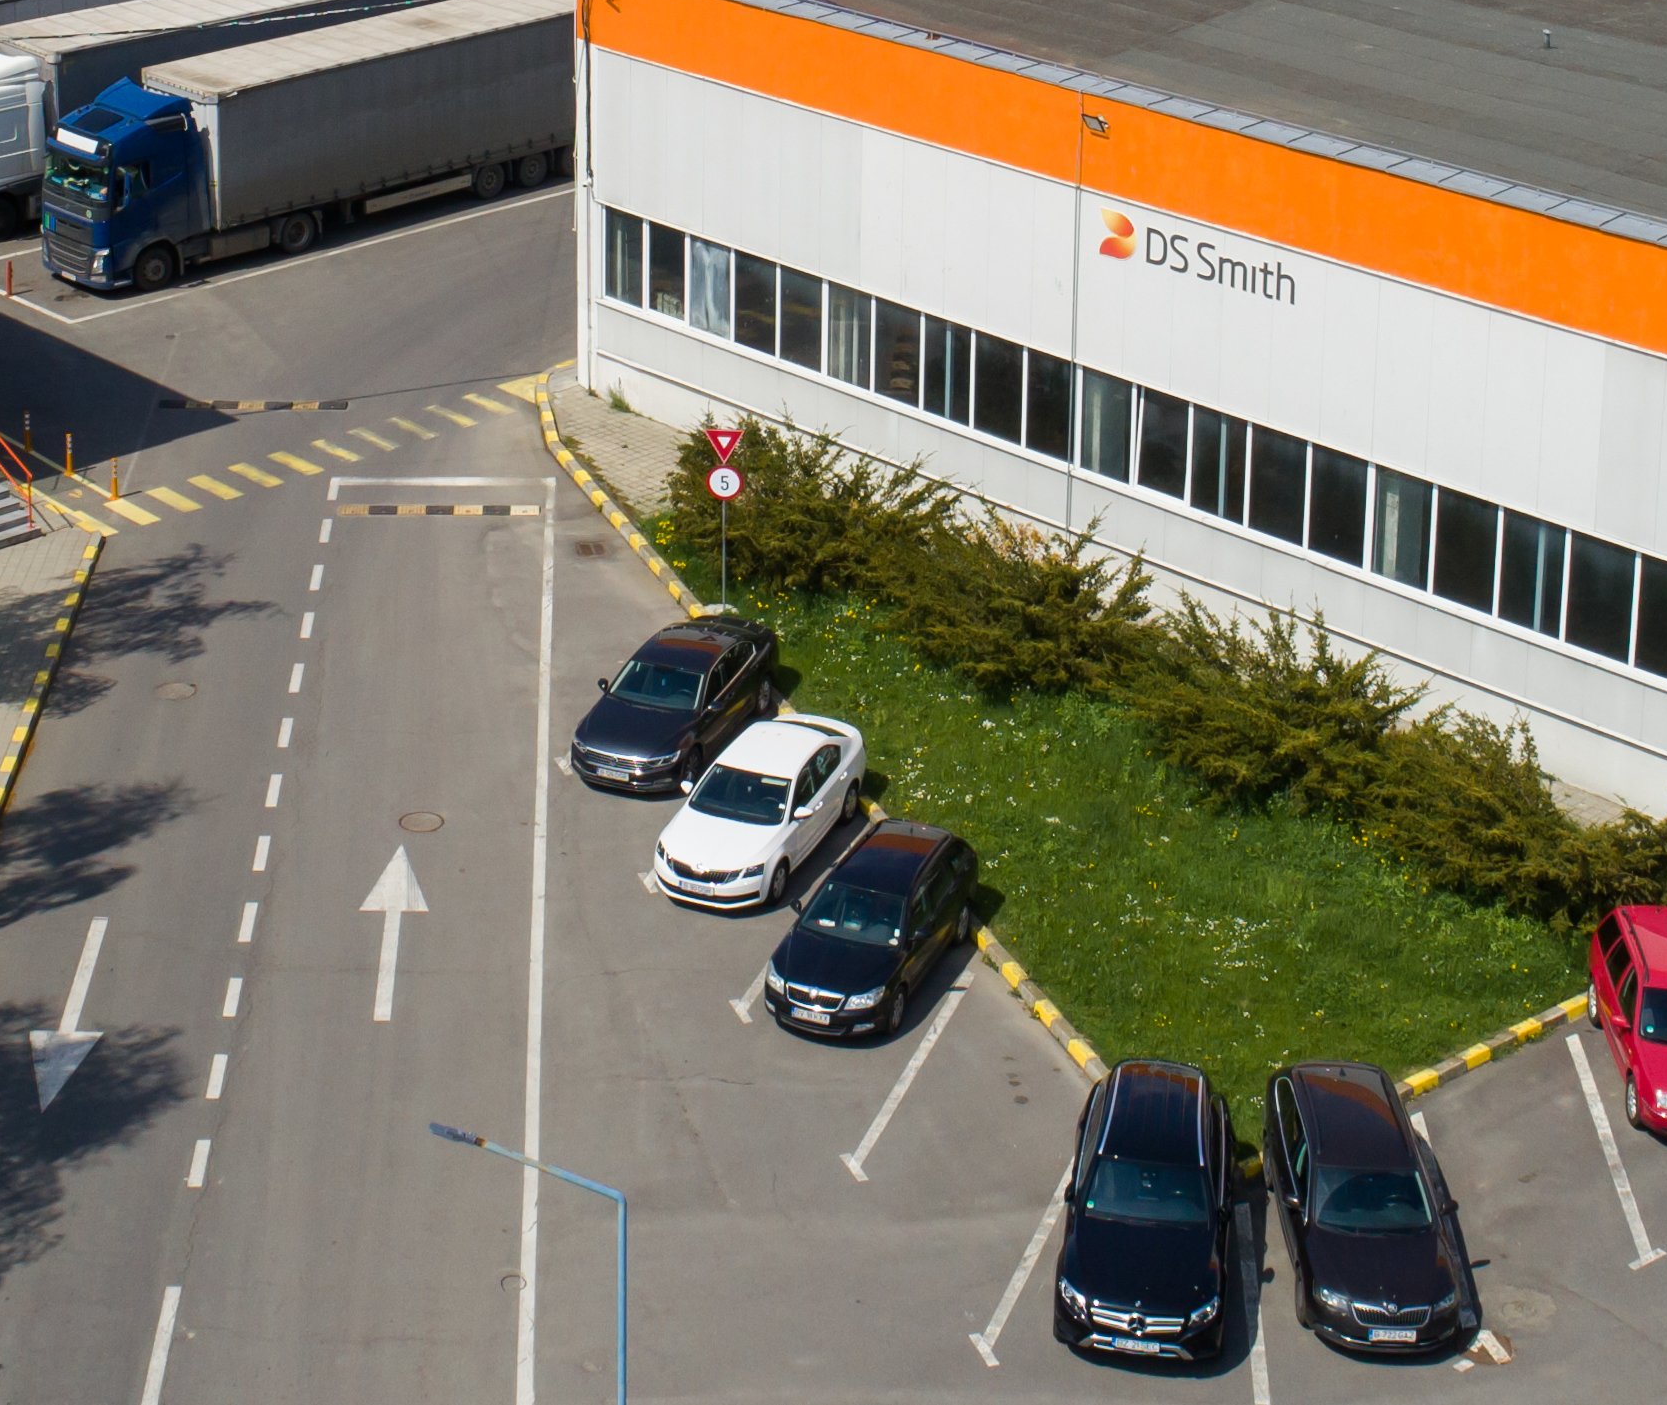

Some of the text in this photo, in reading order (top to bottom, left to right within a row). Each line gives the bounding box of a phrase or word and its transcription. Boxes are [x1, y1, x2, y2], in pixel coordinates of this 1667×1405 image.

[1145, 226, 1296, 305] DS Smith
[720, 475, 729, 491] 5
